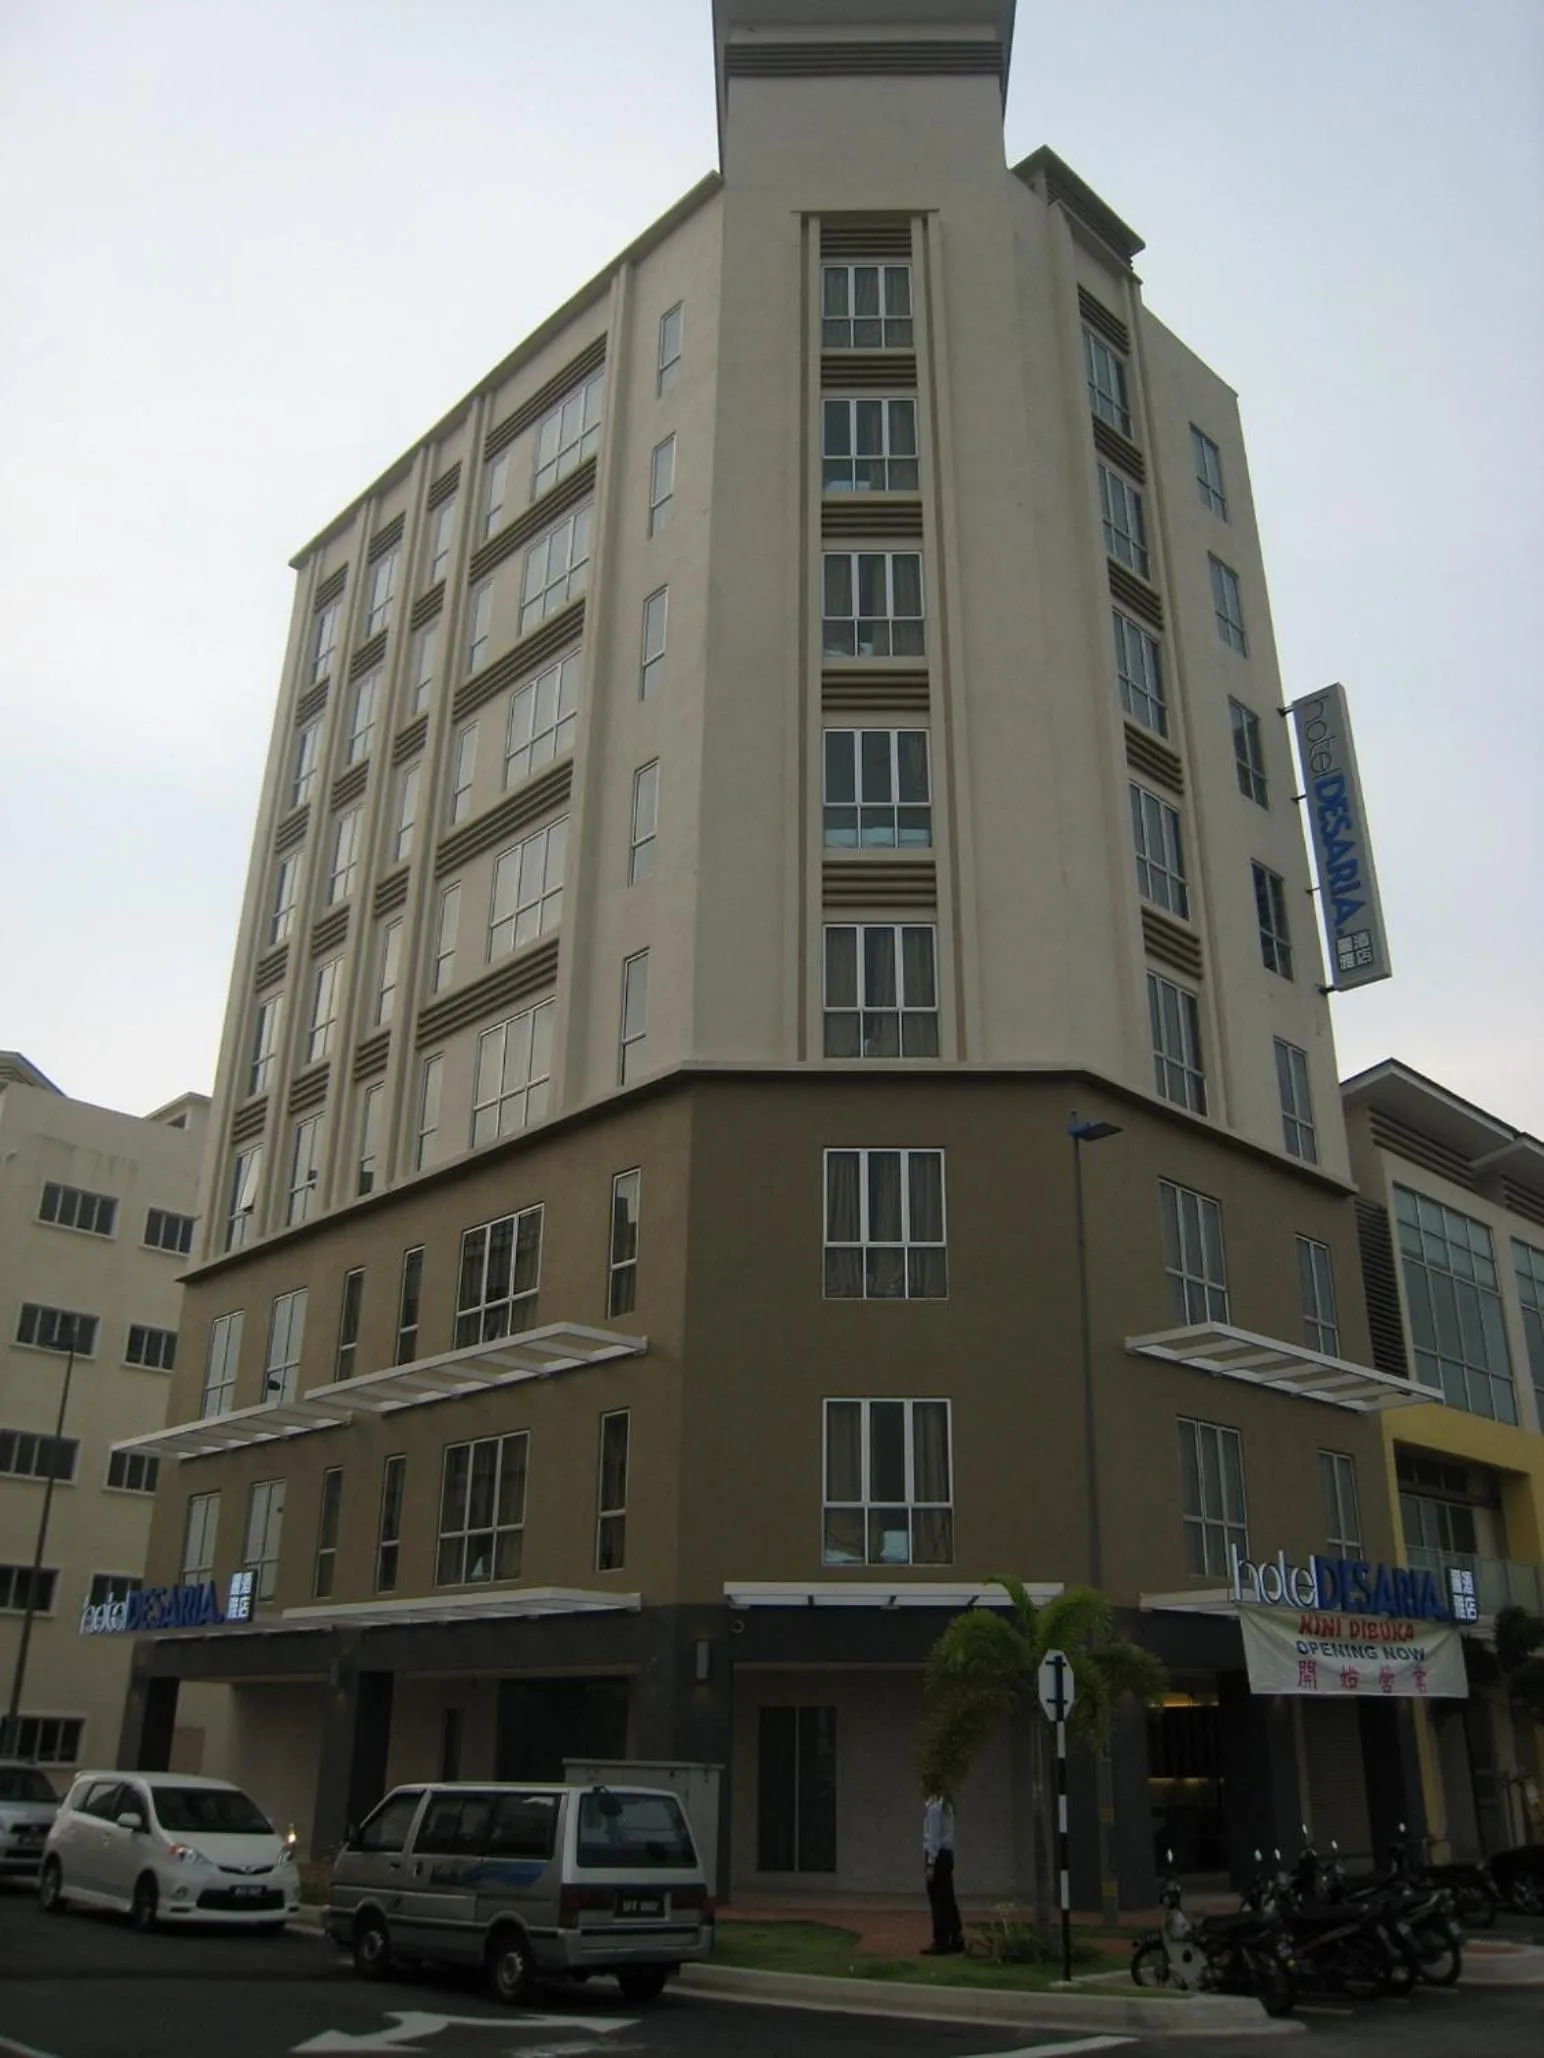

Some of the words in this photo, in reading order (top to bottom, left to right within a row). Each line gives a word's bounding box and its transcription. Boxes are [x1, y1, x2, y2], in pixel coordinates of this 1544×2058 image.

[1299, 1613, 1341, 1637] KINI
[1349, 1619, 1414, 1642] DIBUKA
[1296, 1640, 1378, 1659] OPENING
[1382, 1646, 1426, 1662] NOW
